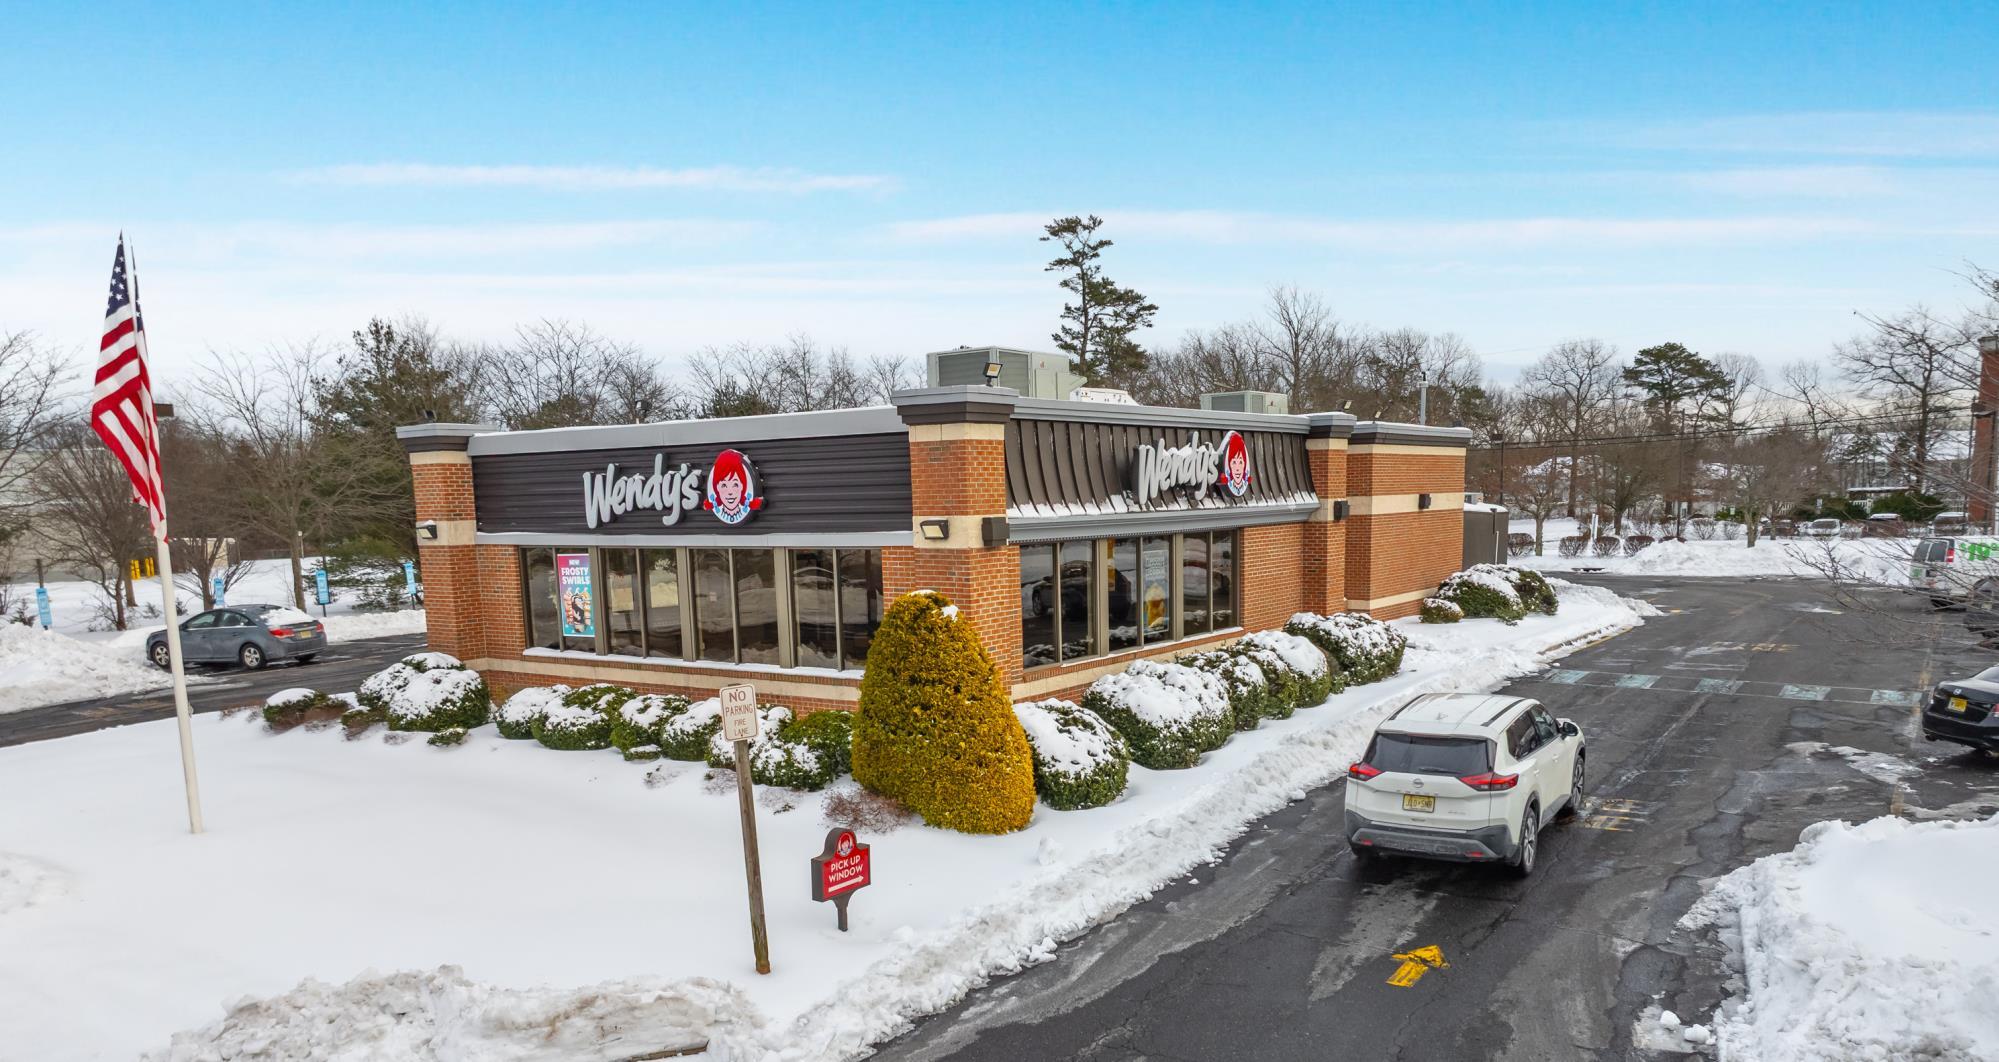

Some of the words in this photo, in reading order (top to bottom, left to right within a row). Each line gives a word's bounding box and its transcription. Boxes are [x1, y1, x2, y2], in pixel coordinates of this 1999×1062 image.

[1139, 431, 1219, 505] Wendy's
[583, 453, 700, 530] Wendy's
[561, 567, 589, 576] FROSTY
[562, 576, 590, 585] SWIRLS
[729, 691, 746, 702] NO
[725, 704, 753, 717] PARKING
[831, 860, 849, 872] PICK
[850, 855, 861, 865] UP
[829, 864, 864, 882] WINDOW
